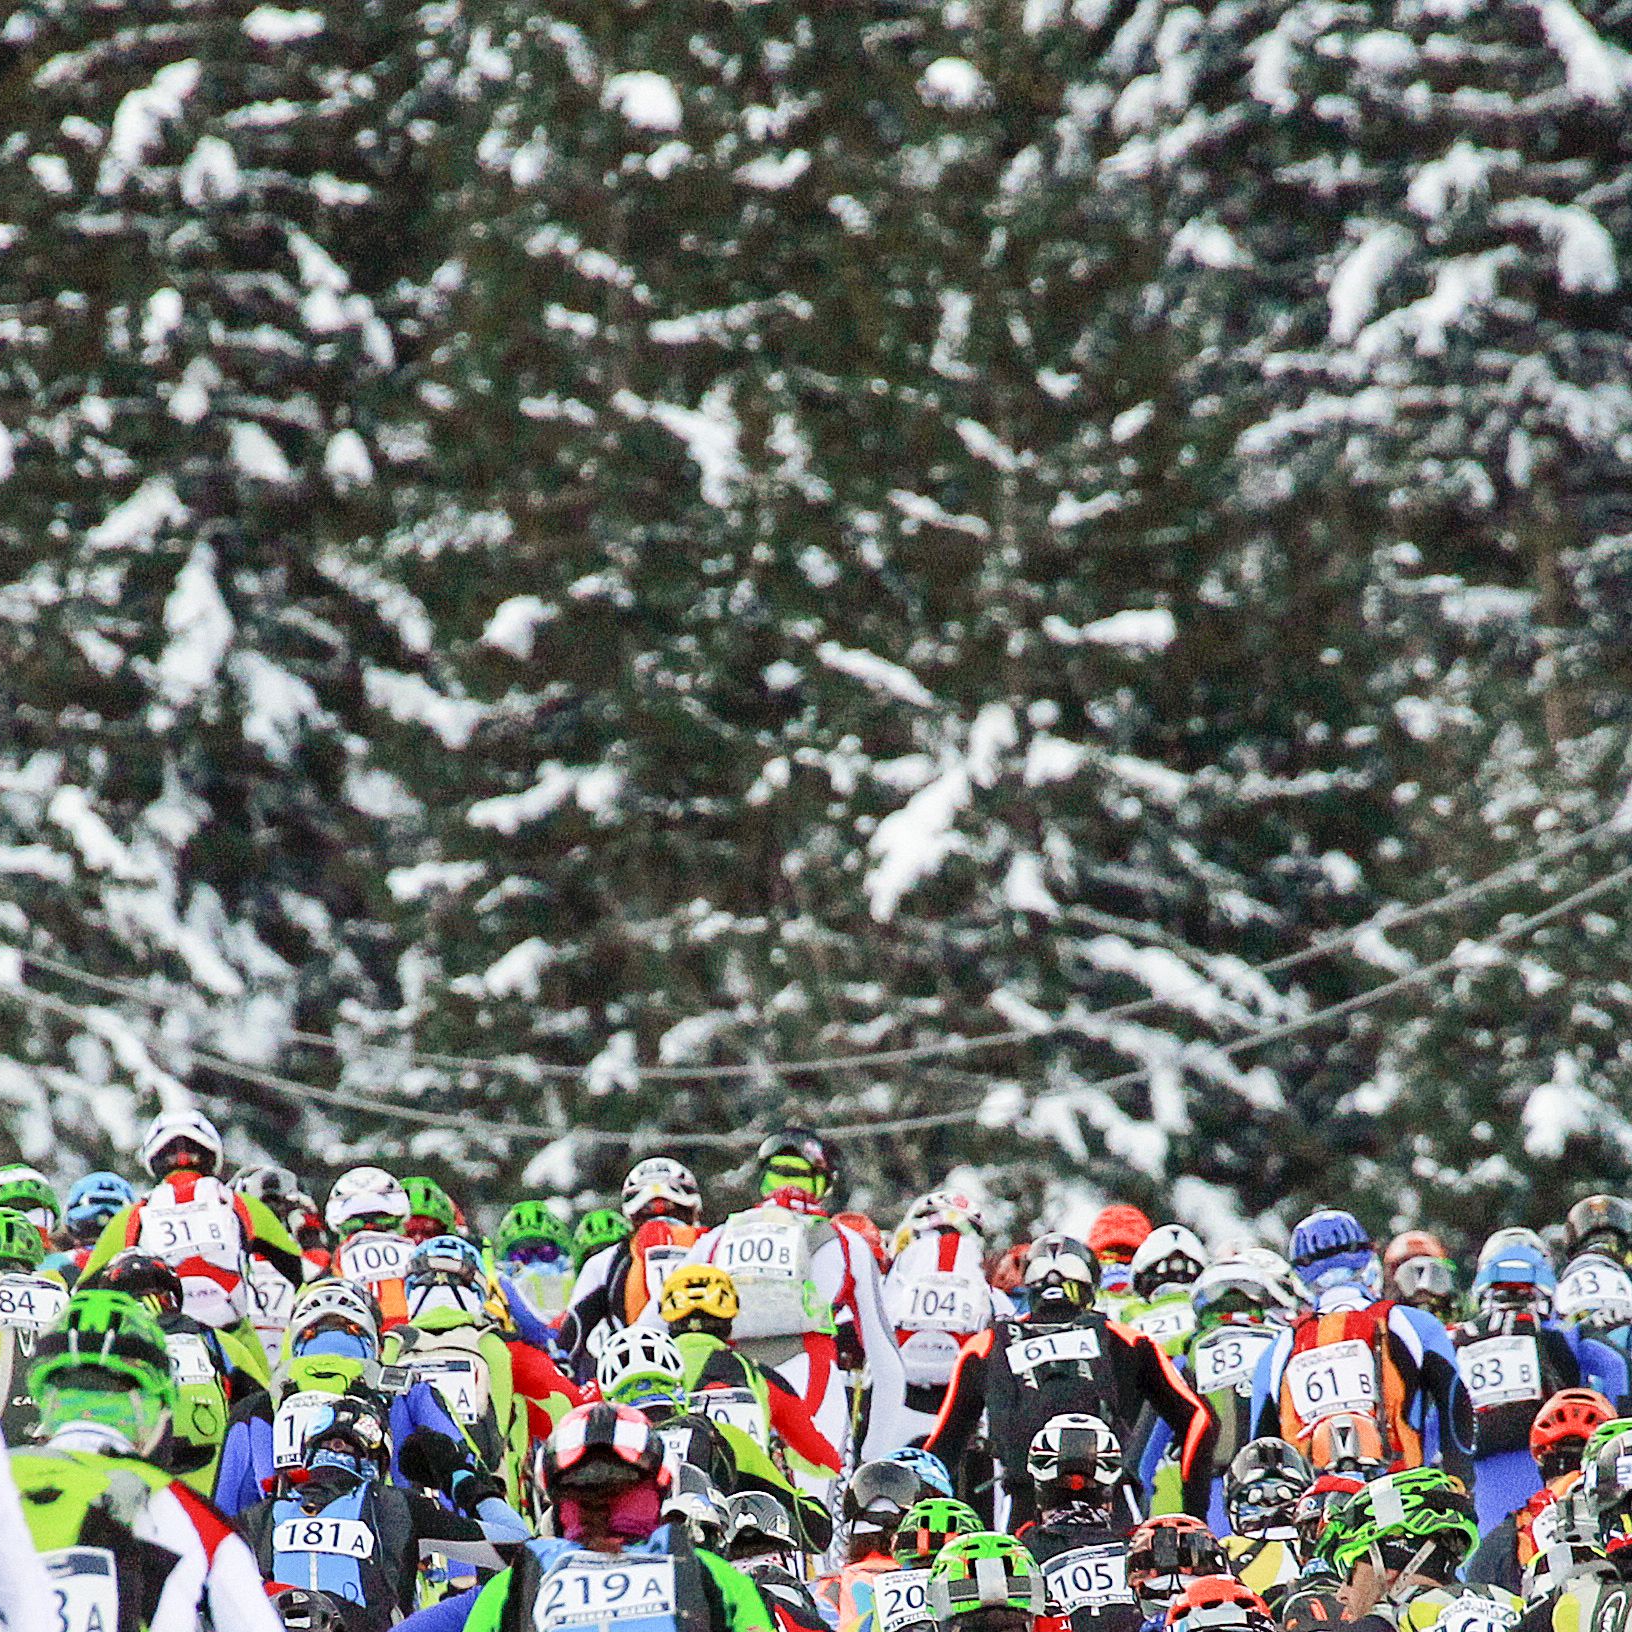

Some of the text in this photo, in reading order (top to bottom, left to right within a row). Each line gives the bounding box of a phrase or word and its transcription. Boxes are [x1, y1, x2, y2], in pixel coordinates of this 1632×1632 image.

[160, 1219, 221, 1247] 31 B
[352, 1245, 400, 1273] 100
[725, 1237, 790, 1265] 100 B
[1569, 1270, 1600, 1296] 43
[911, 1287, 956, 1317] 104
[1024, 1337, 1093, 1361] 61 A
[1211, 1342, 1243, 1375] 83
[1306, 1366, 1372, 1403] 61 B
[1471, 1358, 1531, 1391] 83 B
[285, 1521, 366, 1553] 181 A
[545, 1572, 662, 1617] 219 A
[1054, 1563, 1113, 1598] 105
